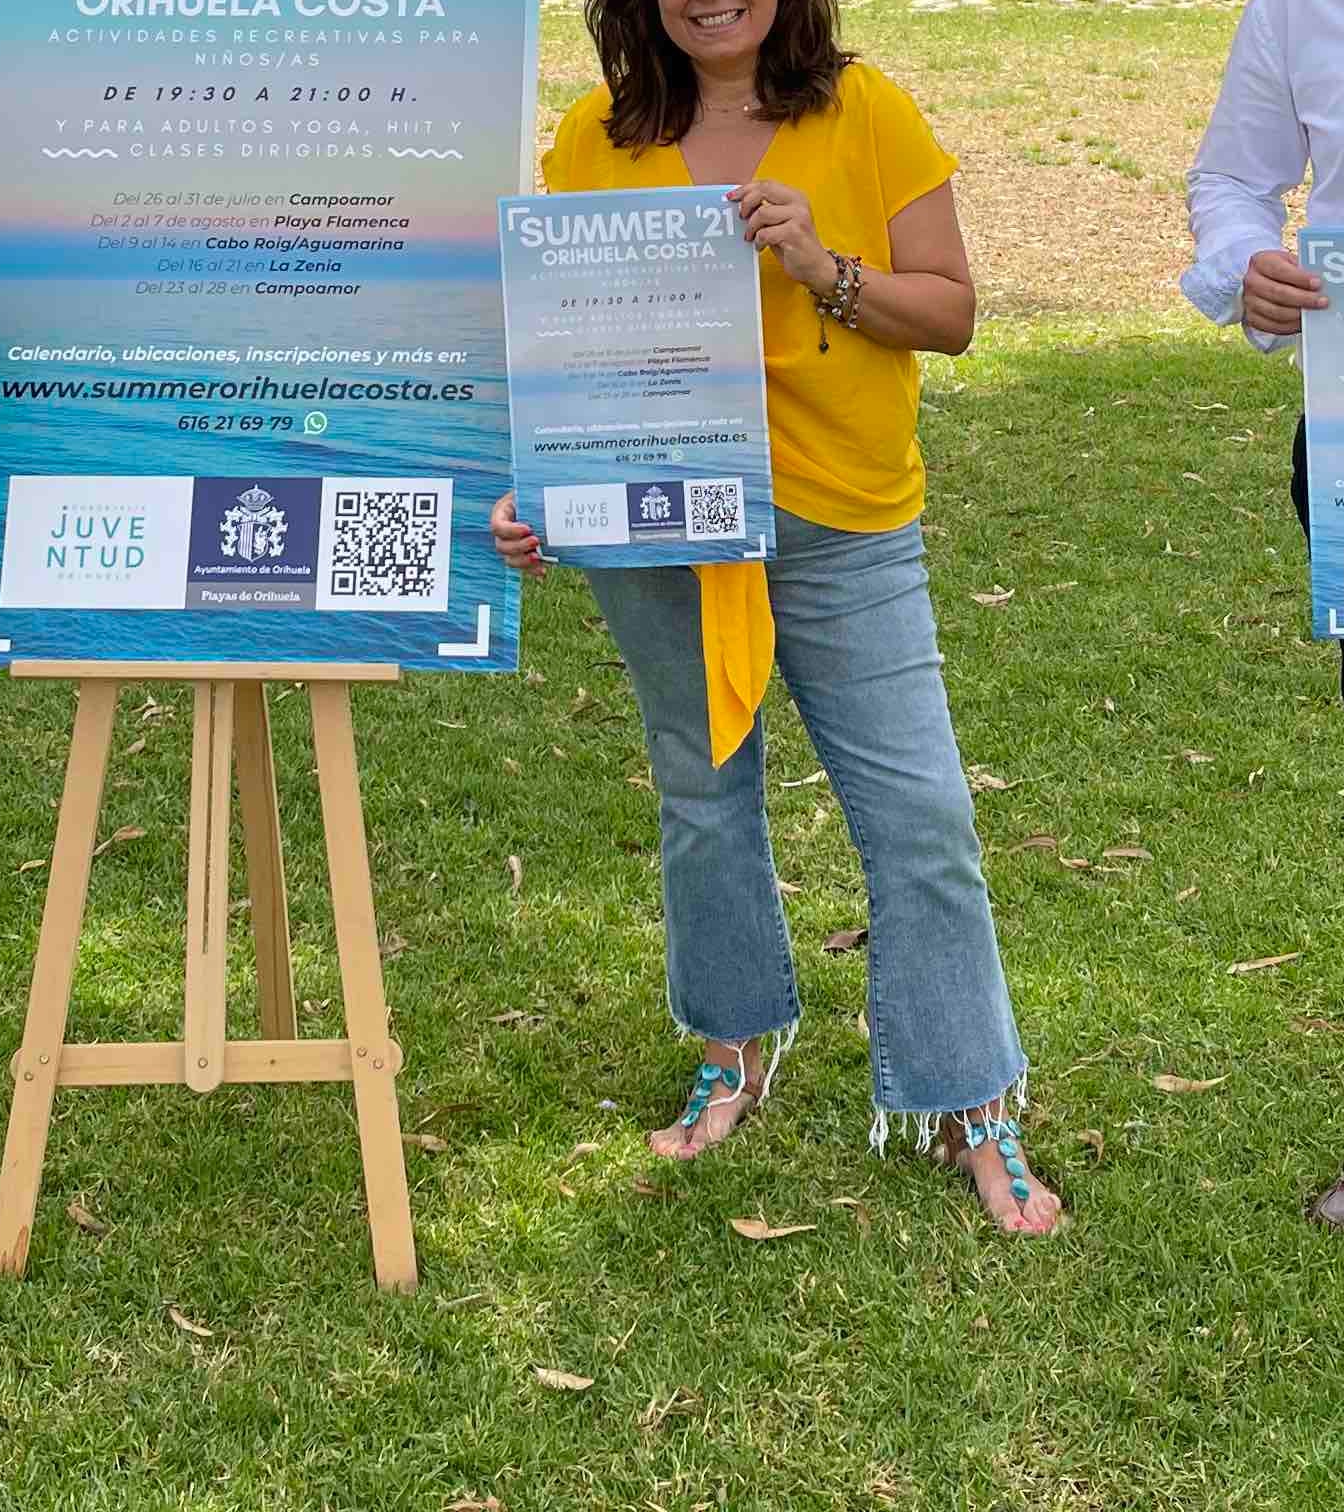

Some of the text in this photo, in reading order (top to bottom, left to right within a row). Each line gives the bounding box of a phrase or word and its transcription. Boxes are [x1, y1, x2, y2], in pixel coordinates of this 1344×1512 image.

[48, 28, 480, 45] ACTIVIDADES RECREATIVAS PARA
[195, 49, 320, 69] NIÑOS/AS
[103, 86, 417, 102] DE 19:30 A 21:00 H.
[55, 119, 68, 133] Y
[84, 119, 144, 134] PARA
[160, 119, 273, 134] ADULTOS
[387, 120, 432, 135] HIIT
[450, 120, 462, 136] Y
[129, 143, 224, 158] CLASES
[112, 192, 140, 206] Del
[166, 192, 182, 206] al
[184, 192, 201, 206] 31
[203, 193, 225, 206] de
[225, 193, 261, 209] julio
[264, 196, 285, 207] en
[288, 193, 395, 209] Campoamor
[90, 214, 410, 231] Del 2 al 7 de agosto en Playa Flamenca
[520, 205, 735, 247] SUMMER '21
[97, 236, 126, 249] Del
[127, 236, 139, 250] 9
[141, 236, 158, 250] al
[179, 239, 201, 250] en
[205, 236, 249, 250] Cabo
[254, 235, 404, 253] Roig/Aguamarina
[541, 241, 716, 266] ORIHUELA COSTA
[157, 258, 185, 272] Del
[206, 258, 222, 272] al
[224, 259, 241, 272] 21
[243, 262, 265, 273] en
[269, 259, 290, 273] La
[293, 259, 342, 273] Zenia
[135, 281, 361, 297] Del 23 al 28 en Campoamor
[7, 345, 467, 366] Calendario, ubicaciones, inscripciones y más en:
[2, 376, 474, 400] www.summerorihuelacosta.es
[178, 415, 293, 430] 616 21 69 79
[534, 431, 747, 452] www.summerorihuelacosta.es
[47, 546, 144, 568] NTUD
[259, 566, 271, 574] de
[201, 590, 301, 603] Playas de Orihuela
